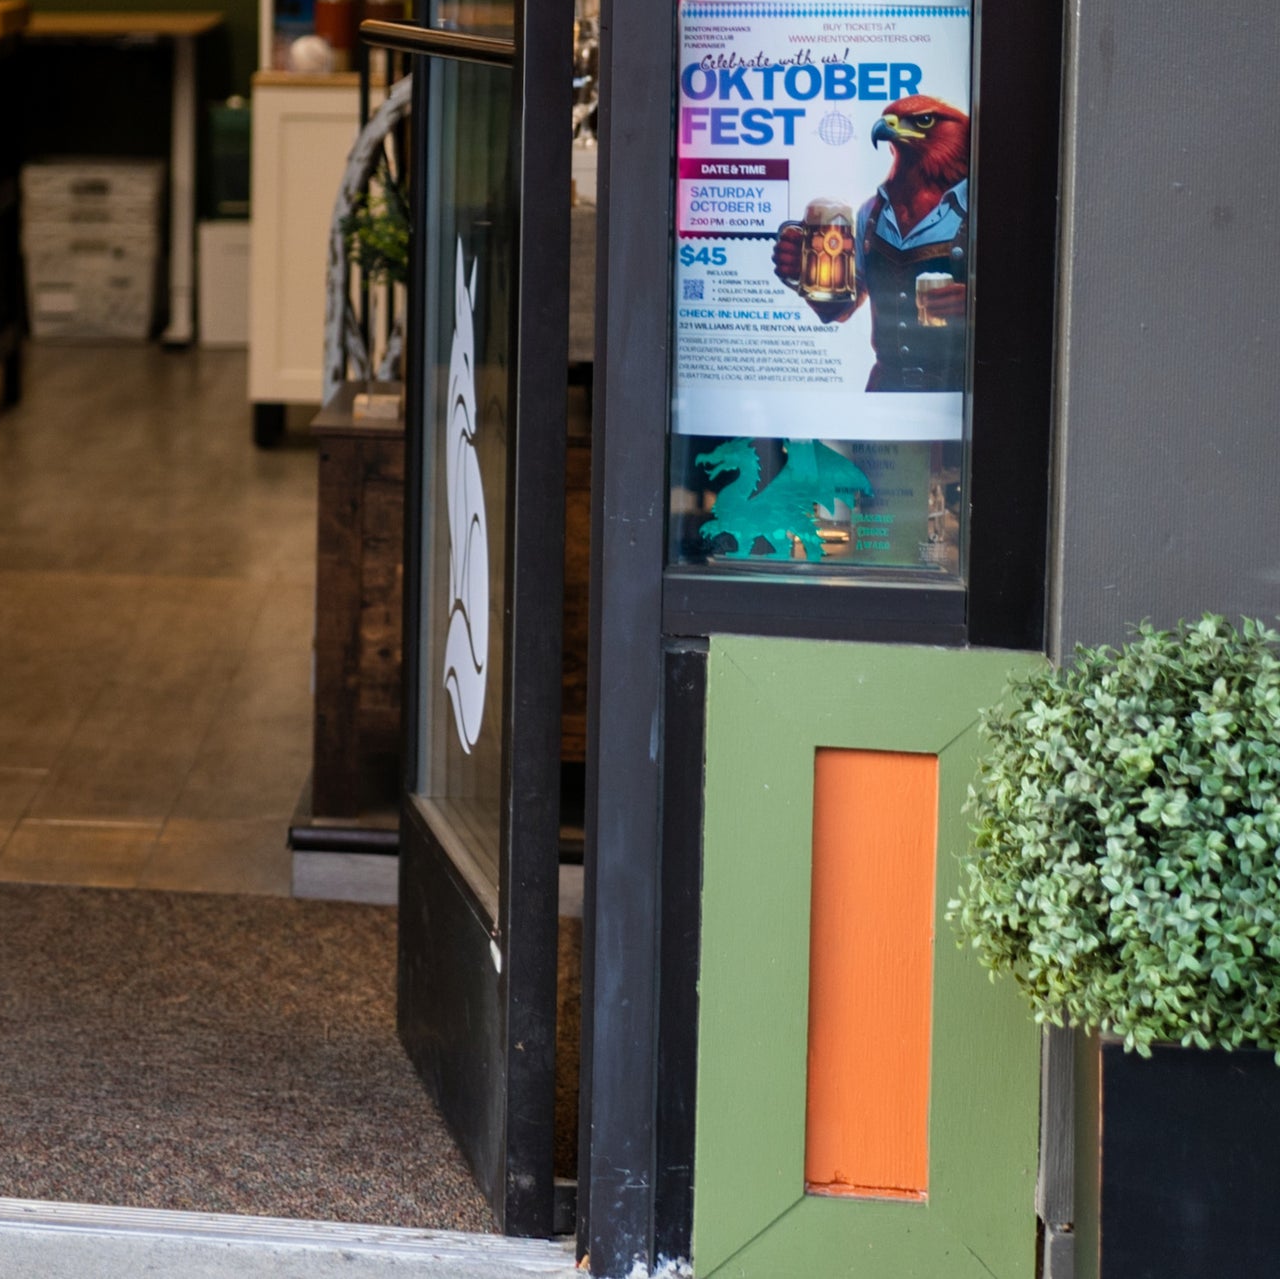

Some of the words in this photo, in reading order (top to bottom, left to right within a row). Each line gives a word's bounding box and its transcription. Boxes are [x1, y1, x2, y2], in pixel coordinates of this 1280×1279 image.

[822, 23, 841, 31] BUY
[844, 23, 883, 31] TICKETS
[884, 23, 896, 31] AT
[699, 51, 775, 71] Celebrate
[779, 49, 815, 67] with
[821, 47, 849, 64] us!
[681, 62, 922, 101] OKTOBER
[682, 108, 806, 146] FEST
[701, 164, 729, 175] DATE
[738, 165, 767, 176] TIME
[690, 186, 765, 199] SATURDAY
[690, 200, 754, 213] OCTOBER
[757, 201, 772, 213] 18
[690, 218, 709, 226] 2:00
[710, 218, 724, 226] PM
[750, 218, 765, 227] PM
[680, 244, 727, 267] $45
[732, 310, 770, 320] UNCLE
[773, 311, 801, 320] MO'S
[693, 322, 734, 331] WILLIAMS
[735, 323, 751, 331] AVE
[797, 325, 812, 333] WA
